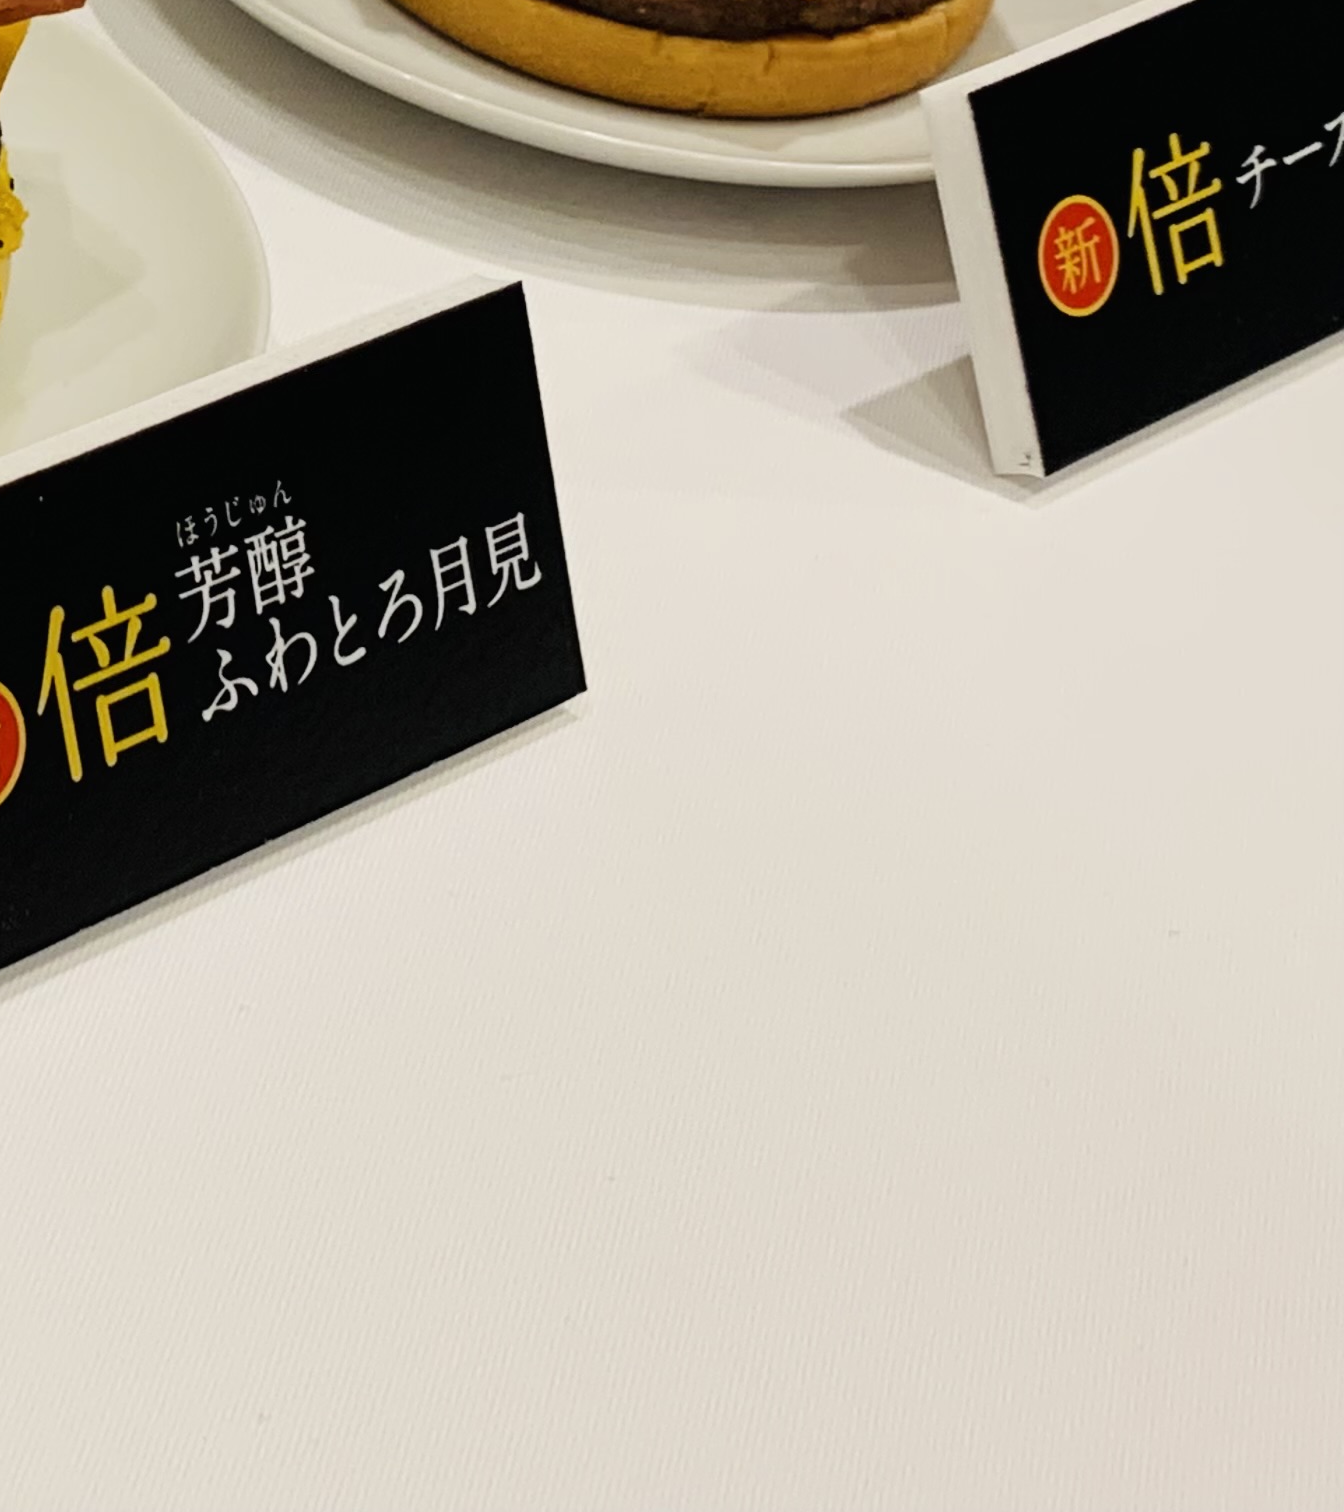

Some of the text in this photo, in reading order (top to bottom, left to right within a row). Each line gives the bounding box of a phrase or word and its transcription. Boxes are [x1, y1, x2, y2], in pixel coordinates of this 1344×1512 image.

[1053, 216, 1103, 295] 新
[1126, 132, 1223, 296] 倍
[174, 515, 316, 644] 芳醇
[176, 480, 292, 549] ほうじゅん
[36, 585, 172, 783] 倍
[201, 511, 543, 723] ふわとろ月見
